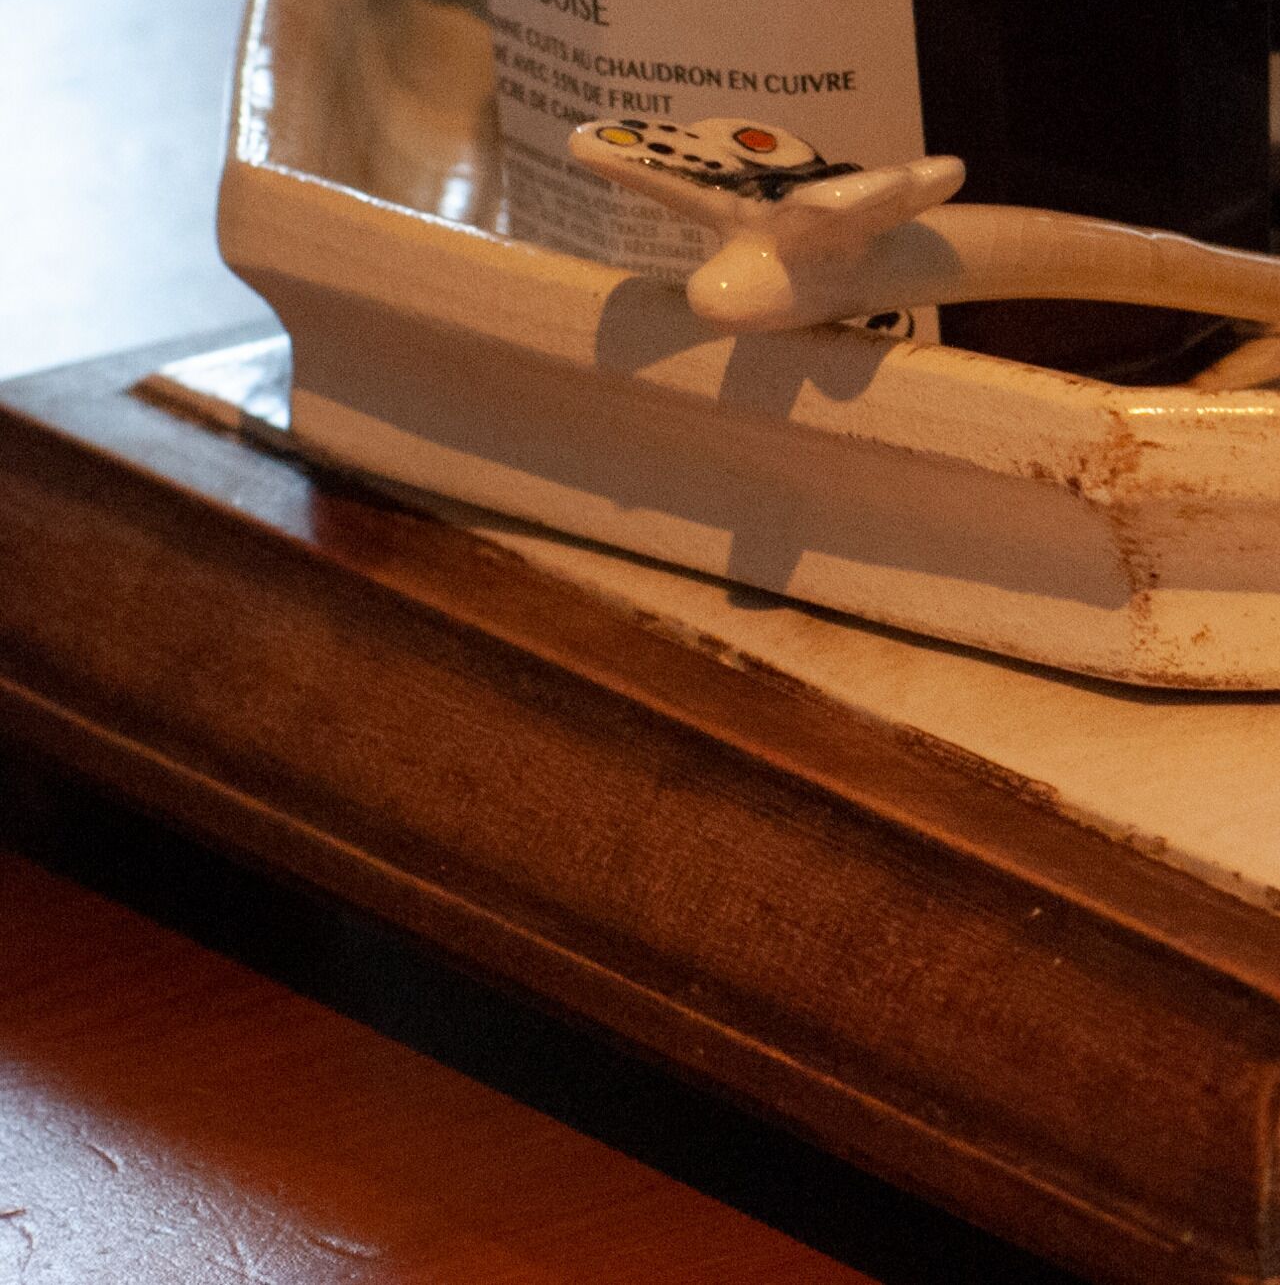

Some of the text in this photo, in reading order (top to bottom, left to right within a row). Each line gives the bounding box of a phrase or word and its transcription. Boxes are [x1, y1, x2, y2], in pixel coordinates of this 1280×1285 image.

[593, 55, 722, 90] CHAUDRON
[728, 69, 758, 93] EN
[764, 70, 857, 96] CUIVRE
[608, 87, 674, 115] FRUIT
